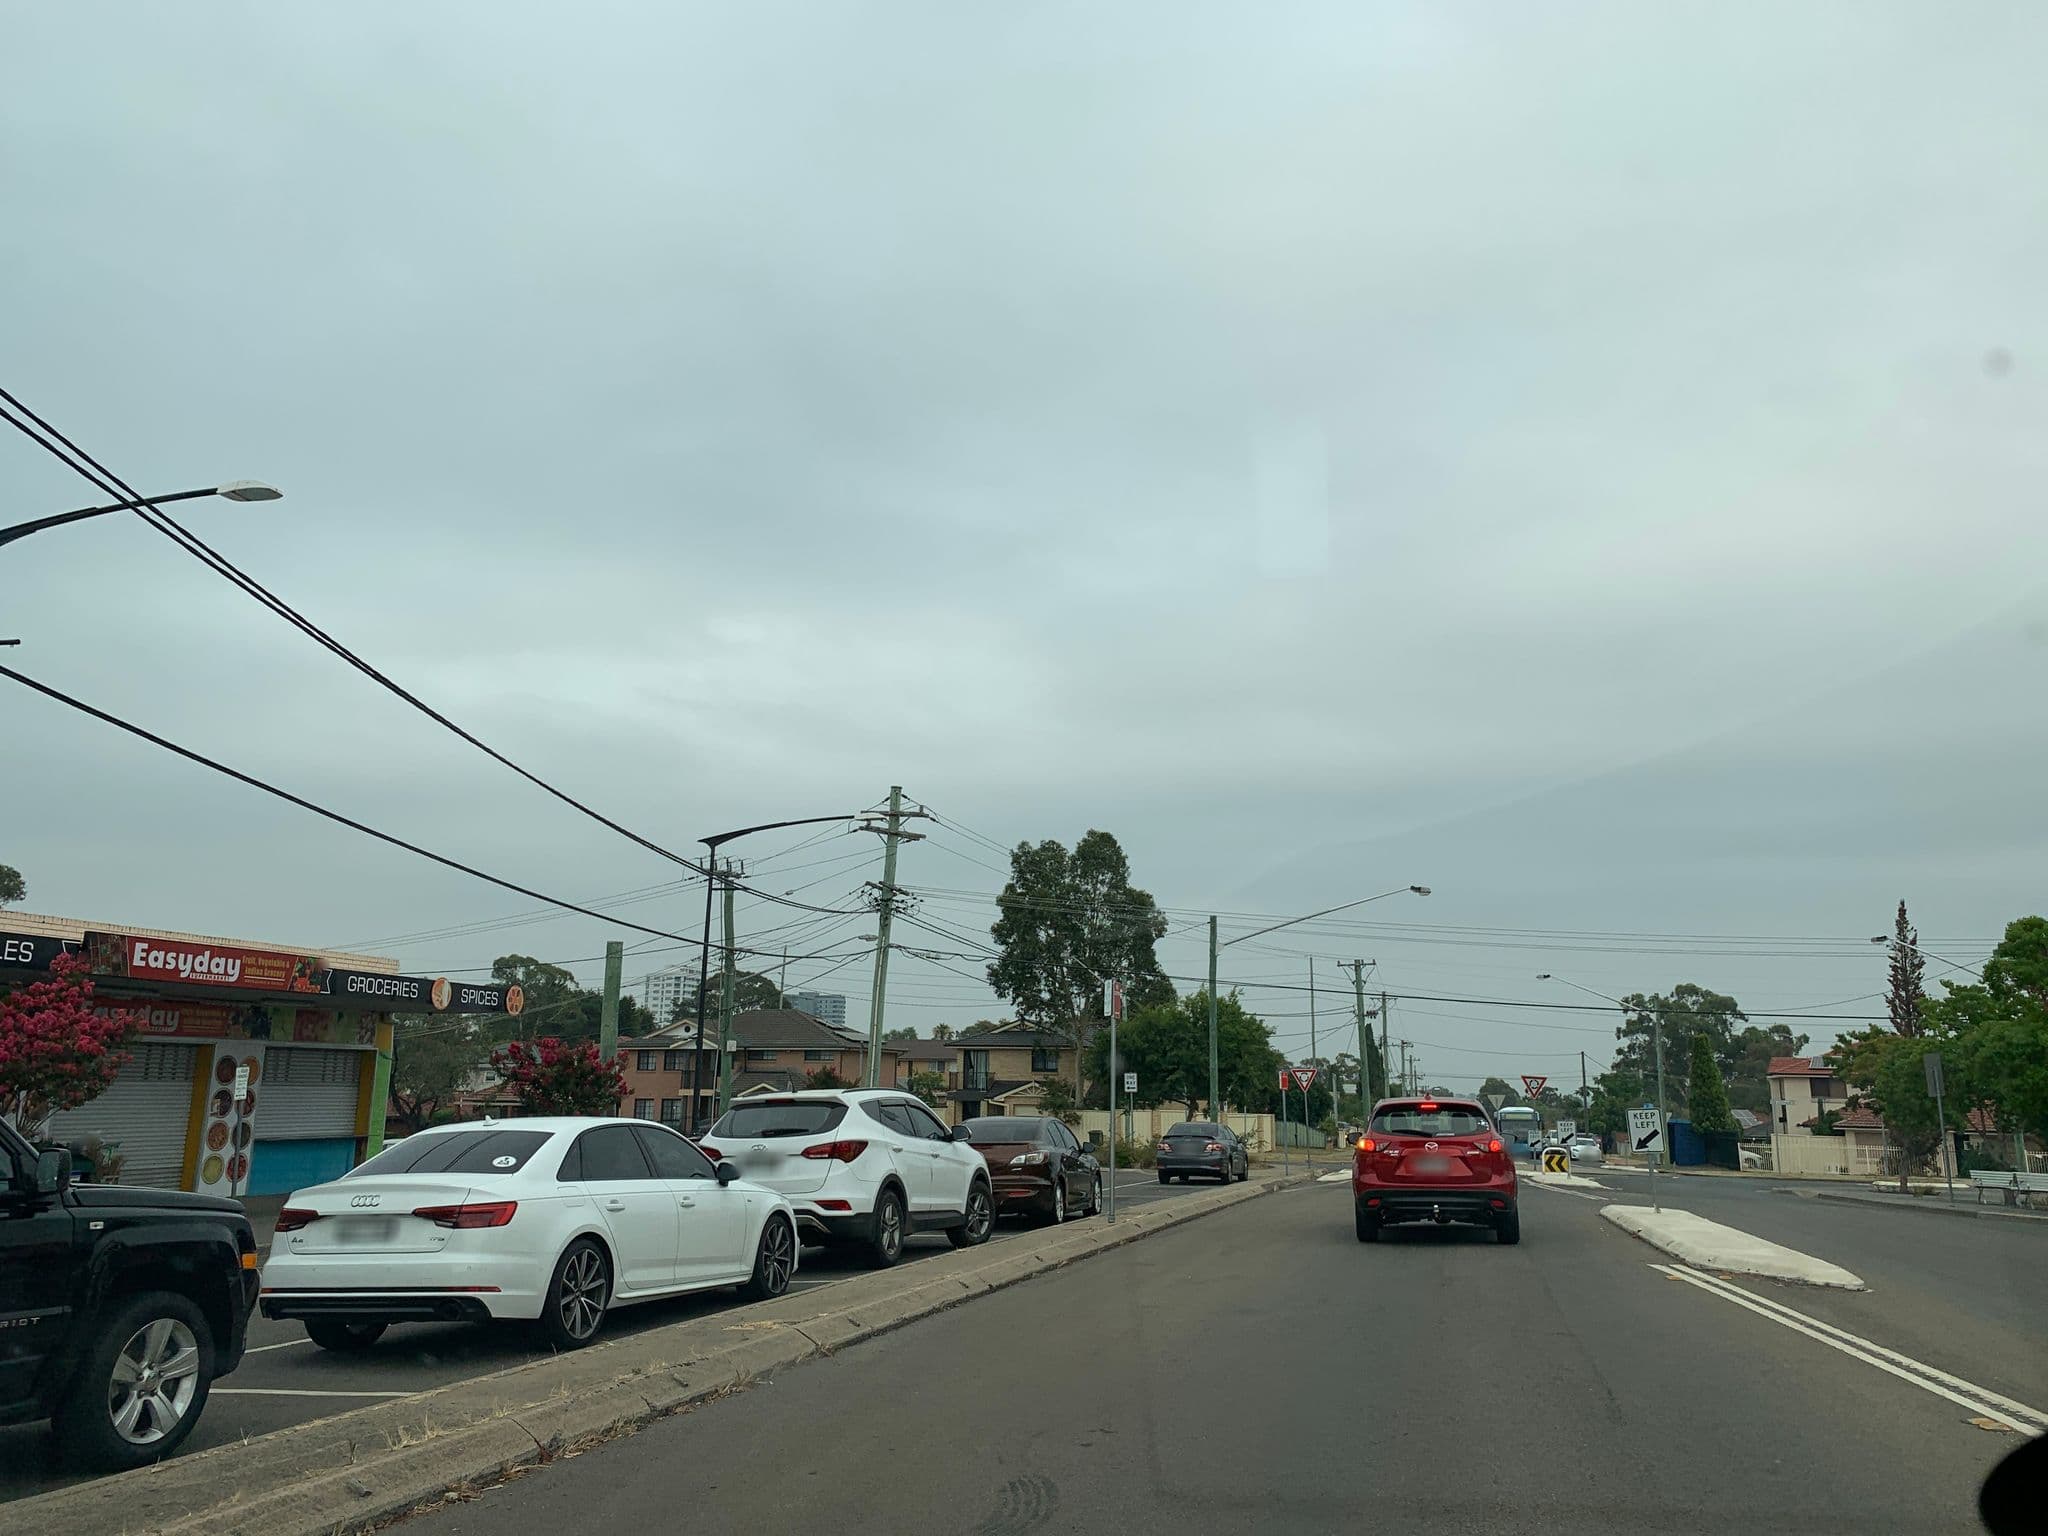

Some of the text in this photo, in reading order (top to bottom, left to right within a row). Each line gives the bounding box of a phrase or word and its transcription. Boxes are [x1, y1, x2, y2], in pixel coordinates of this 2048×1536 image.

[0, 940, 34, 962] ES
[133, 942, 241, 982] Easyday
[347, 976, 419, 998] GROCERIES
[461, 988, 499, 1006] SPICES
[1633, 1112, 1656, 1120] KEEP
[1635, 1121, 1656, 1129] LEFT
